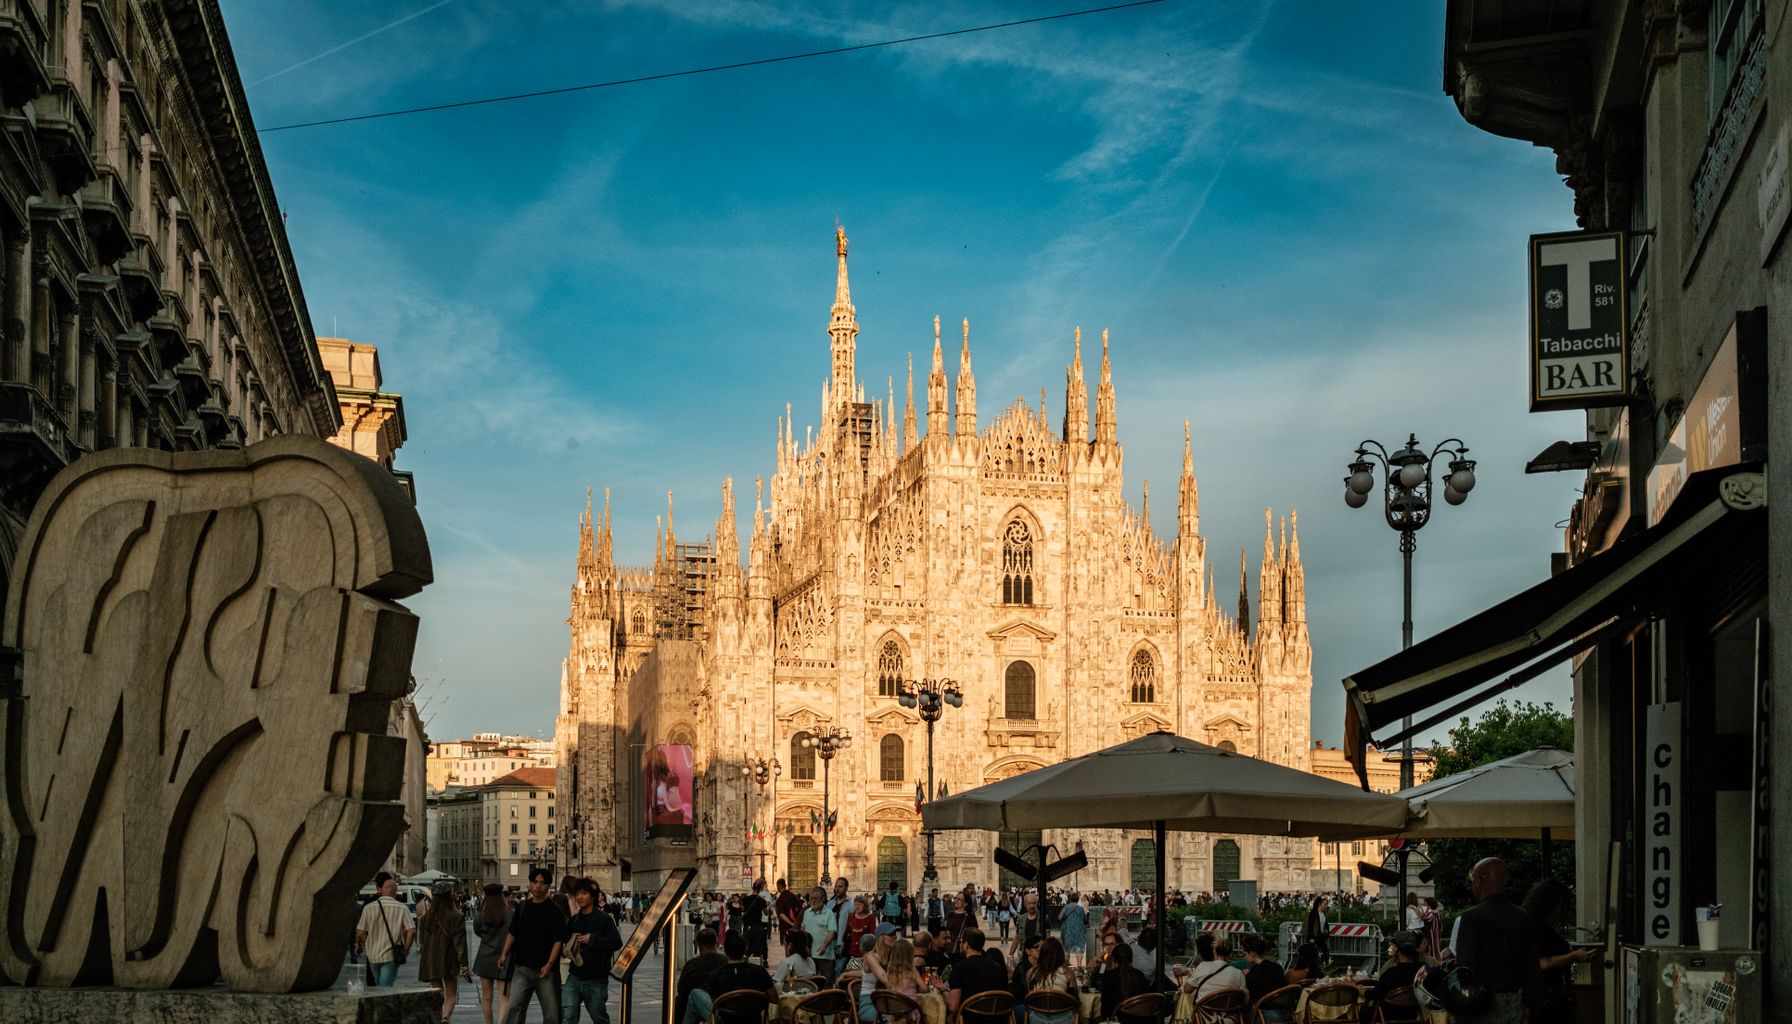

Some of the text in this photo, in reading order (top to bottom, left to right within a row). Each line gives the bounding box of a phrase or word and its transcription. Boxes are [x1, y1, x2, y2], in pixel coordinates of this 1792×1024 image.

[1541, 238, 1616, 331] T
[1594, 284, 1615, 294] Riv.
[1594, 296, 1614, 307] 581
[1540, 333, 1620, 353] Tabacchi
[1545, 360, 1616, 391] BAR
[1651, 743, 1672, 940] change
